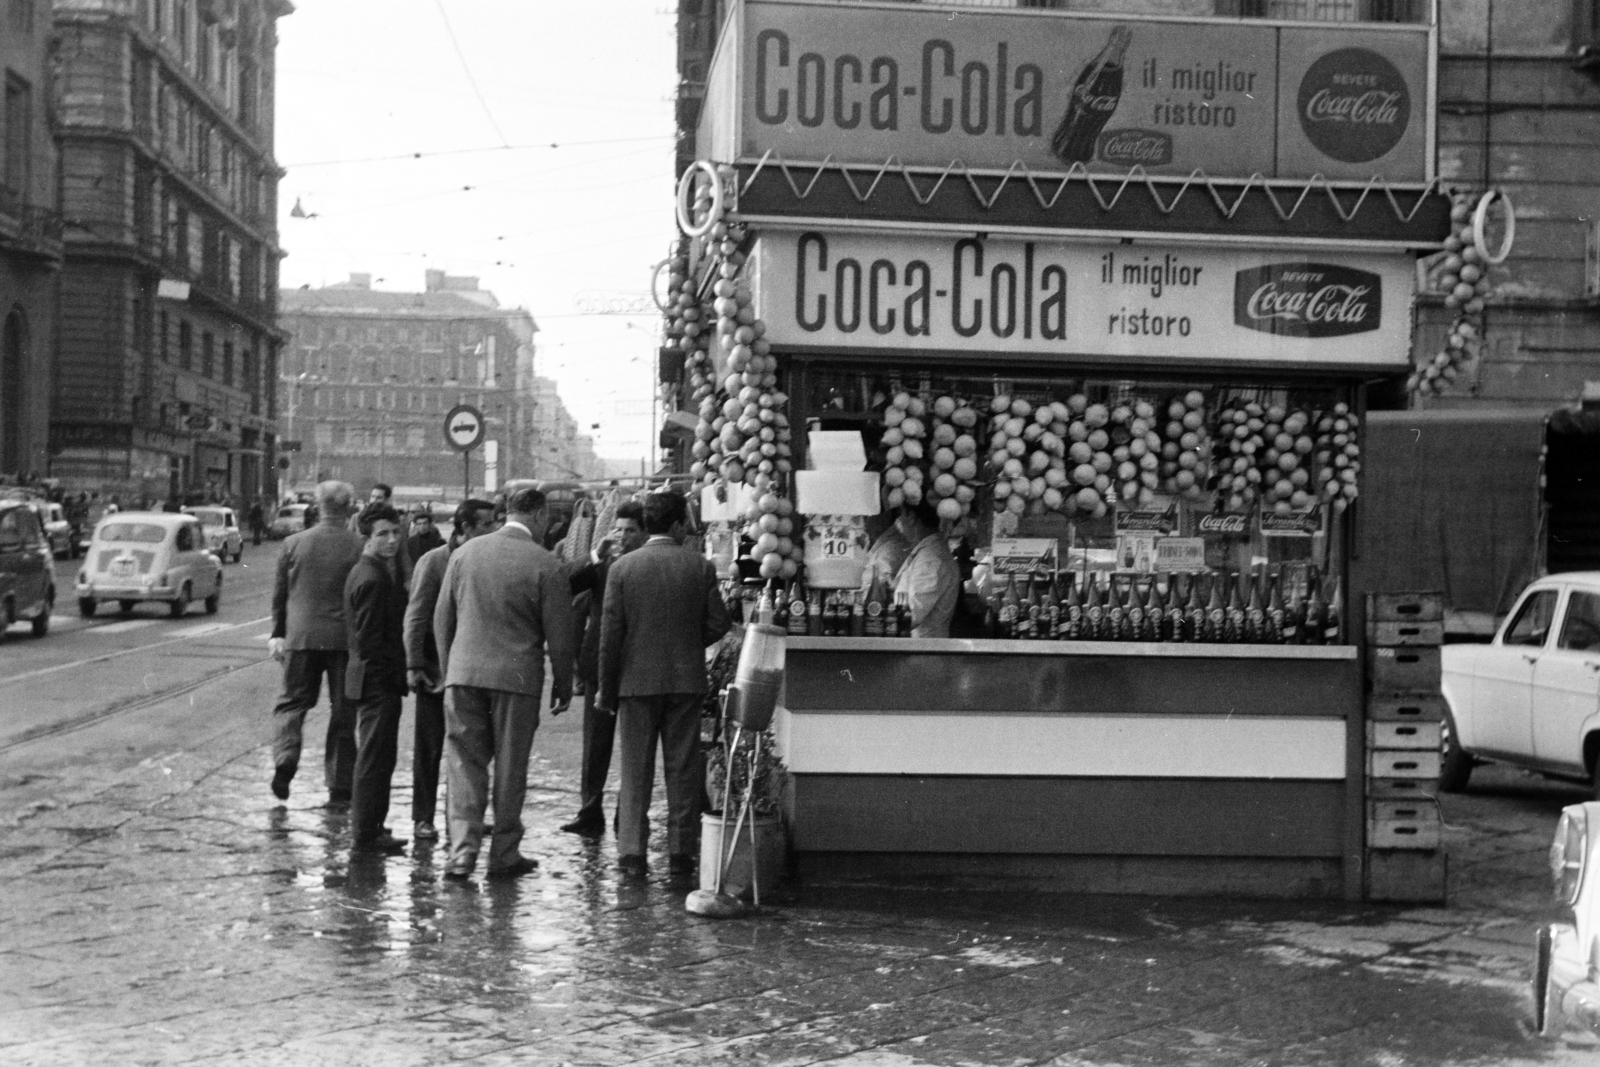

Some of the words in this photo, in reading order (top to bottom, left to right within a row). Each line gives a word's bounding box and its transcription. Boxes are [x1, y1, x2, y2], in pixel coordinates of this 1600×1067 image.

[755, 28, 1044, 138] Coca-Cola
[1143, 58, 1156, 88] il
[1172, 61, 1257, 99] miglior
[1332, 73, 1378, 86] BEVETE
[1154, 99, 1236, 127] ristoro
[1306, 88, 1400, 124] Coca-Cola
[795, 231, 1067, 340] Coca-Cola
[1101, 252, 1114, 284] il
[1122, 254, 1203, 298] miglior
[1281, 271, 1325, 282] BEVETE
[1247, 282, 1373, 322] Coca-Cola
[1109, 307, 1191, 337] ristoro
[824, 540, 848, 556] 10
